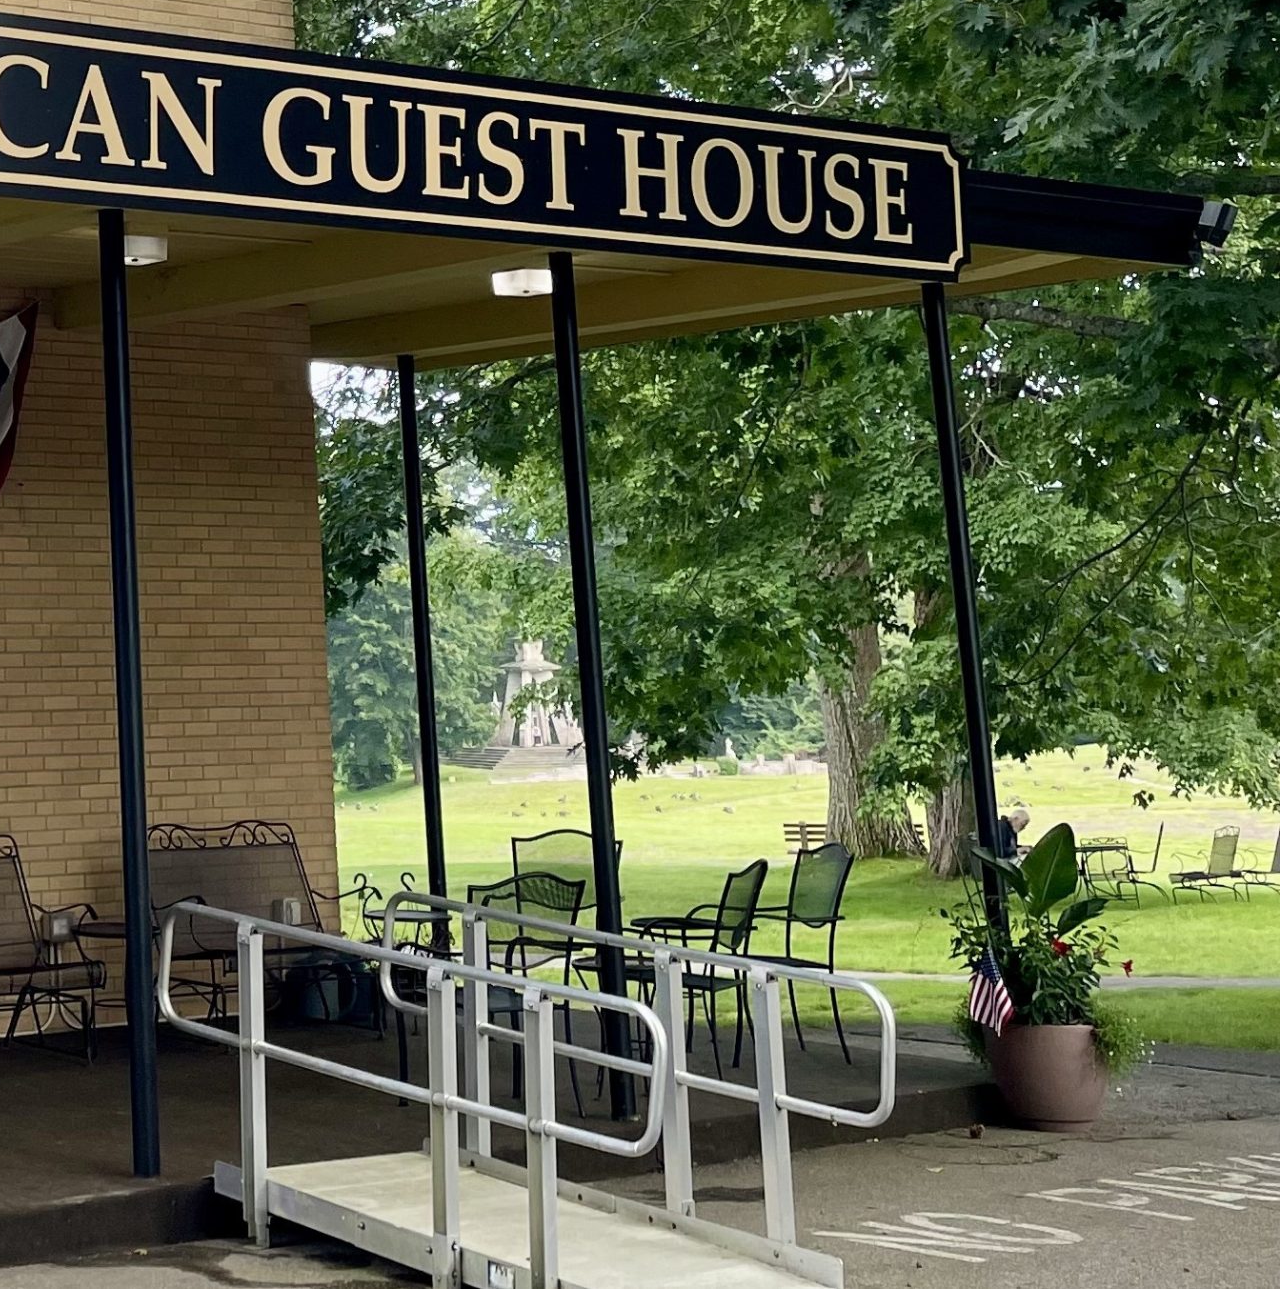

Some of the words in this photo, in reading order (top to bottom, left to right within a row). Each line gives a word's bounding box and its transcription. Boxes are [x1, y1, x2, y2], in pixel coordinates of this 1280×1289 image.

[262, 87, 585, 211] GUEST
[616, 128, 913, 245] HOUSE
[811, 1211, 1084, 1263] NO
